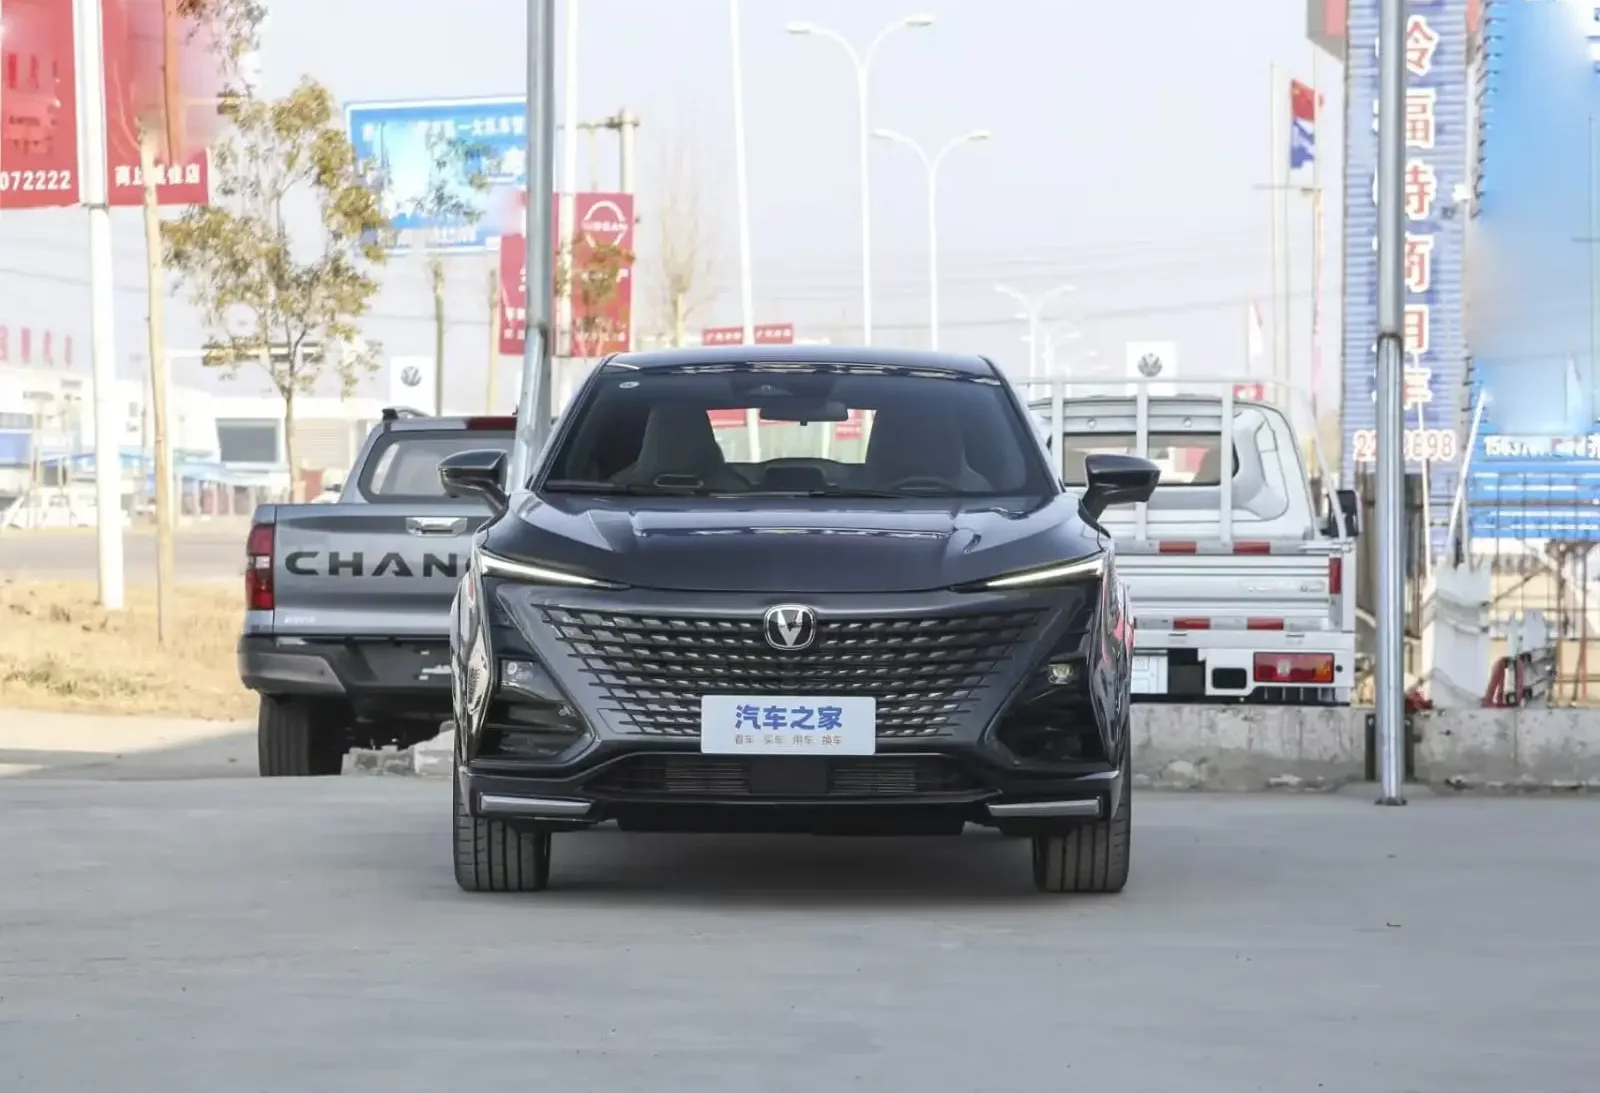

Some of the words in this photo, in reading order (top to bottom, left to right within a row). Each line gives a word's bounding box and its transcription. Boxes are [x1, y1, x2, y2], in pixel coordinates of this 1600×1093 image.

[285, 551, 470, 577] CHAN
[735, 705, 842, 730] 汽车之家
[734, 734, 755, 745] 看车
[763, 734, 784, 745] 买车
[792, 735, 814, 745] 用车
[822, 734, 843, 746] 换车
